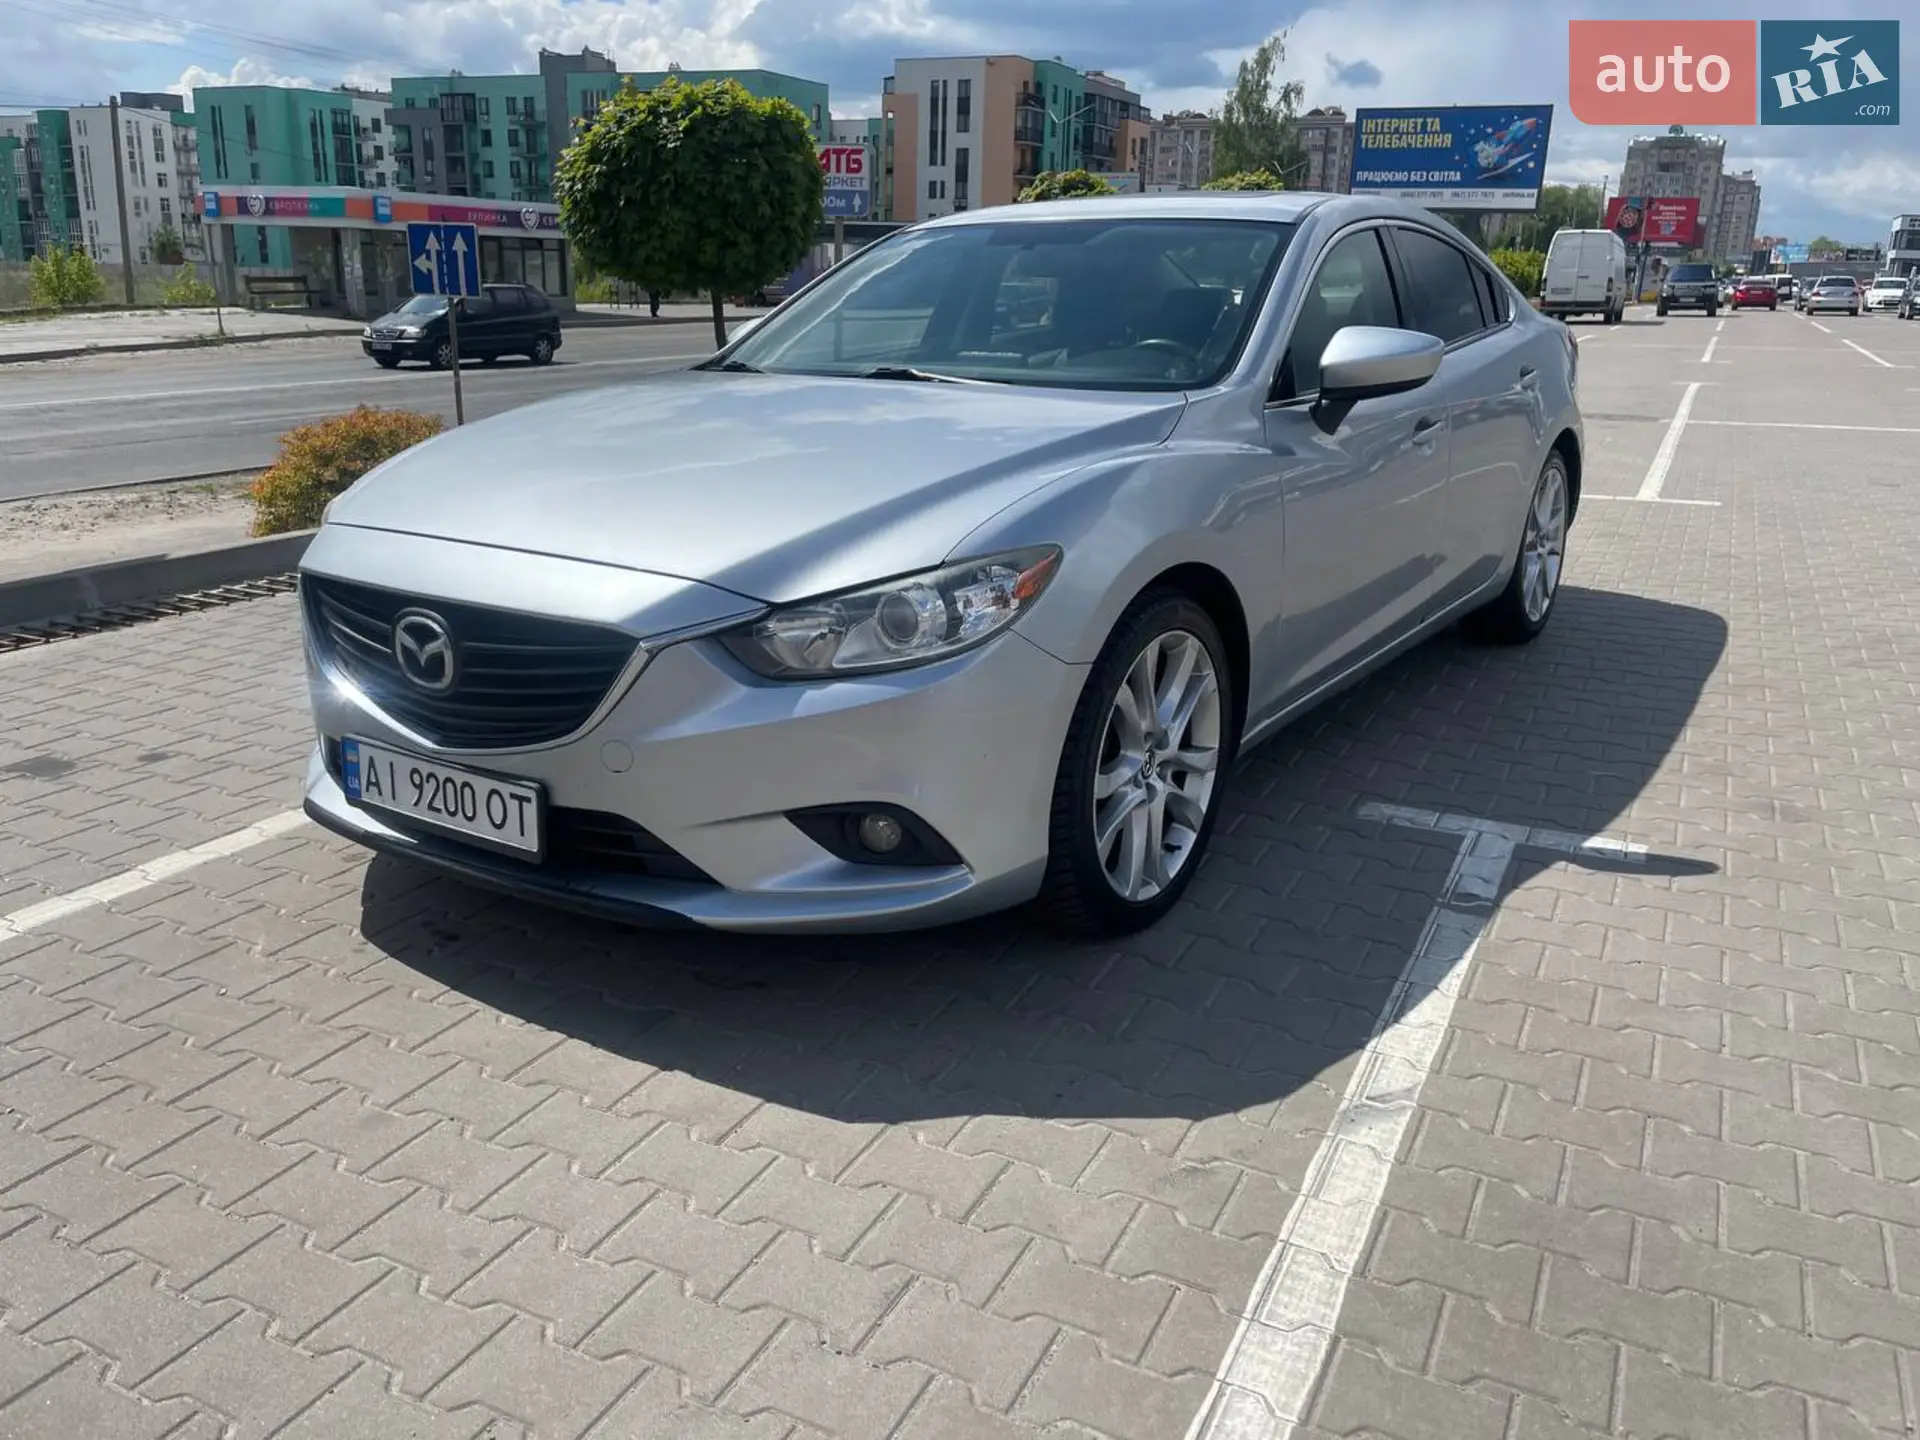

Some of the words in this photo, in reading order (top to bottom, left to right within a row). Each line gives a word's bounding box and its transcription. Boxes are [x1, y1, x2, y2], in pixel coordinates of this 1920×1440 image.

[1361, 117, 1425, 133] ІНТЕРНЕТ
[1426, 117, 1441, 133] ТА
[1361, 133, 1453, 149] ТЕЛЕБАЧЕННЯ
[818, 147, 865, 174] АТБ
[823, 176, 865, 188] АРКЕТ
[1410, 170, 1427, 182] БЕЗ
[1428, 170, 1461, 182] СВІТЛА
[366, 755, 396, 801] AI
[409, 767, 477, 822] 9200
[486, 788, 532, 837] OT
